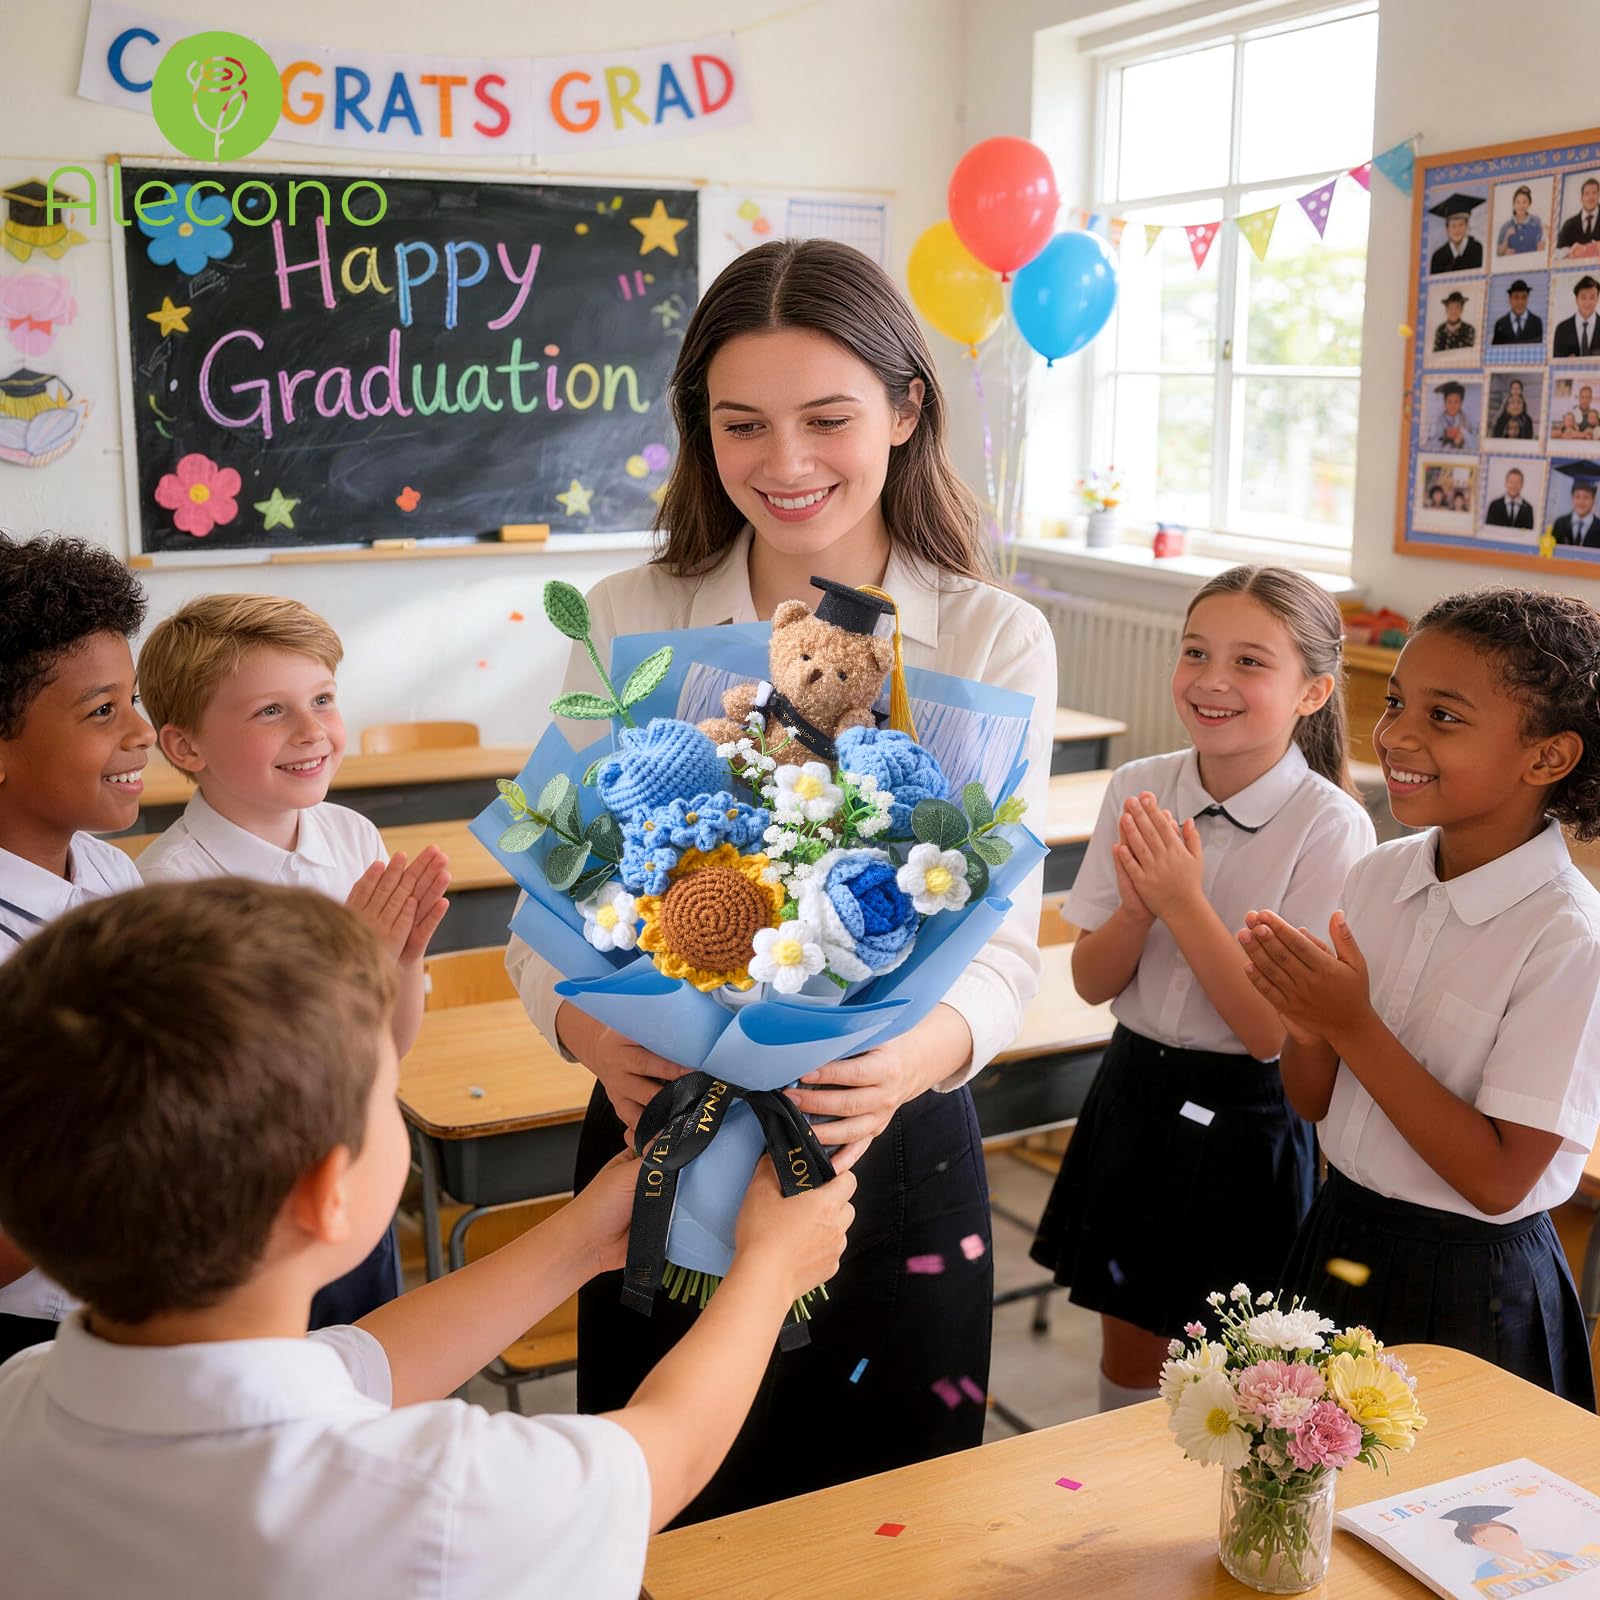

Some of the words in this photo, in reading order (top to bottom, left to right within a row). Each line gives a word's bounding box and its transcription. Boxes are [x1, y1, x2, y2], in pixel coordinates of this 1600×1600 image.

[107, 27, 512, 138] CGRATS
[550, 53, 735, 134] GRAD
[271, 215, 542, 330] Happy
[198, 328, 650, 440] Graduation
[787, 1146, 813, 1195] LOV
